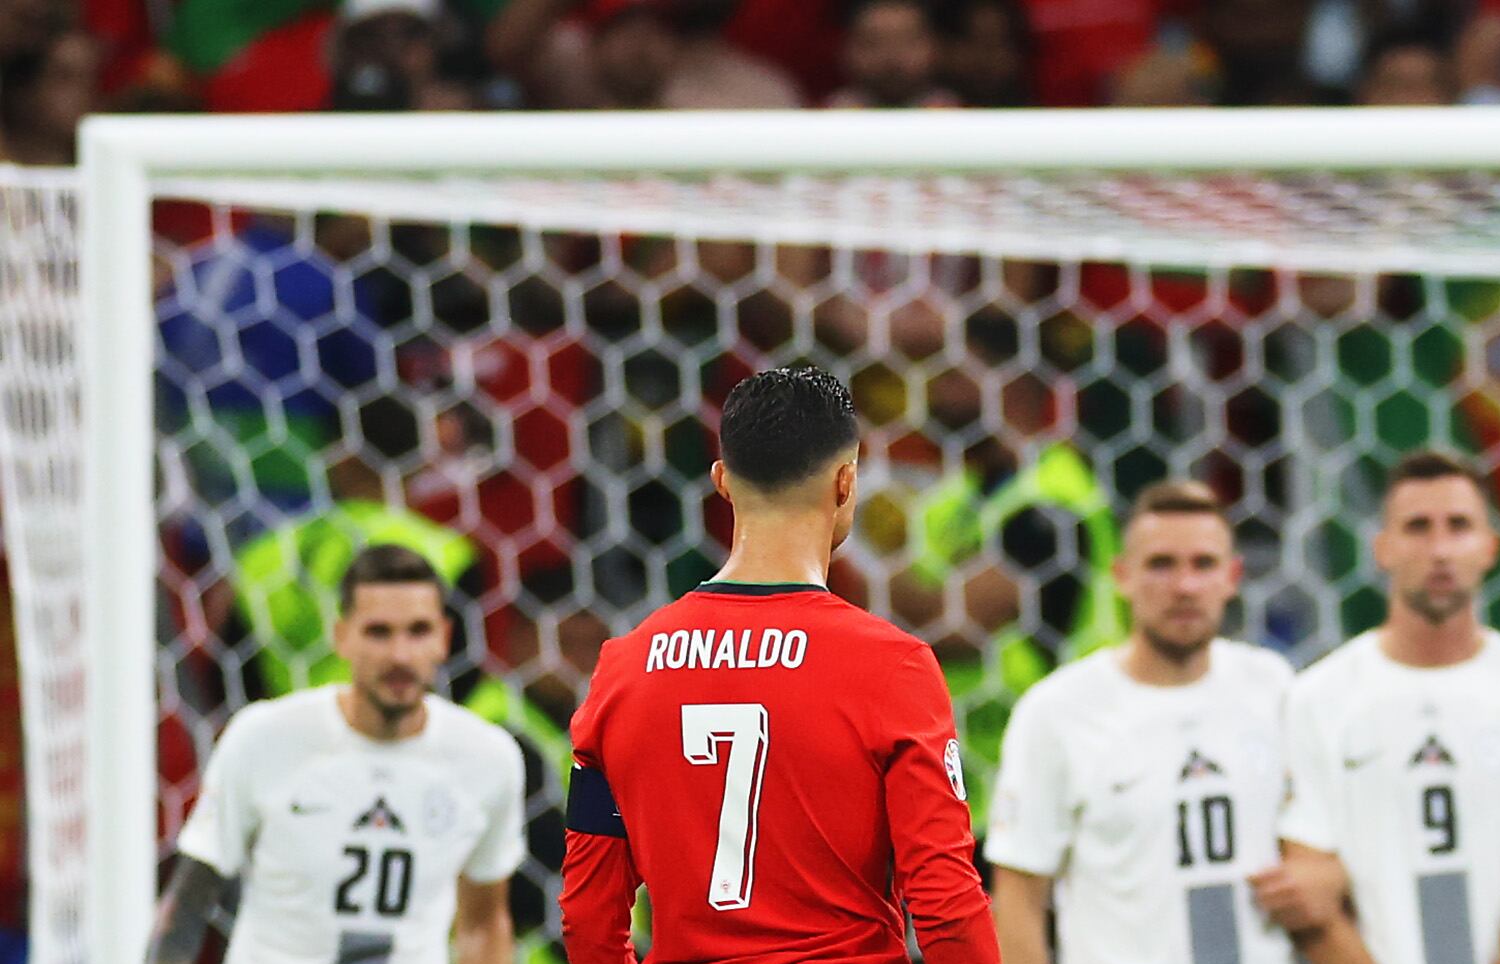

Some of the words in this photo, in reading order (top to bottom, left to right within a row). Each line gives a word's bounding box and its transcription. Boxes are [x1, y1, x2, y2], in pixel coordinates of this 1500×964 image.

[645, 628, 809, 673] RONALDO
[681, 703, 769, 911] 7
[1175, 793, 1236, 869] 10
[1420, 783, 1457, 857] 9
[333, 844, 415, 919] 20
